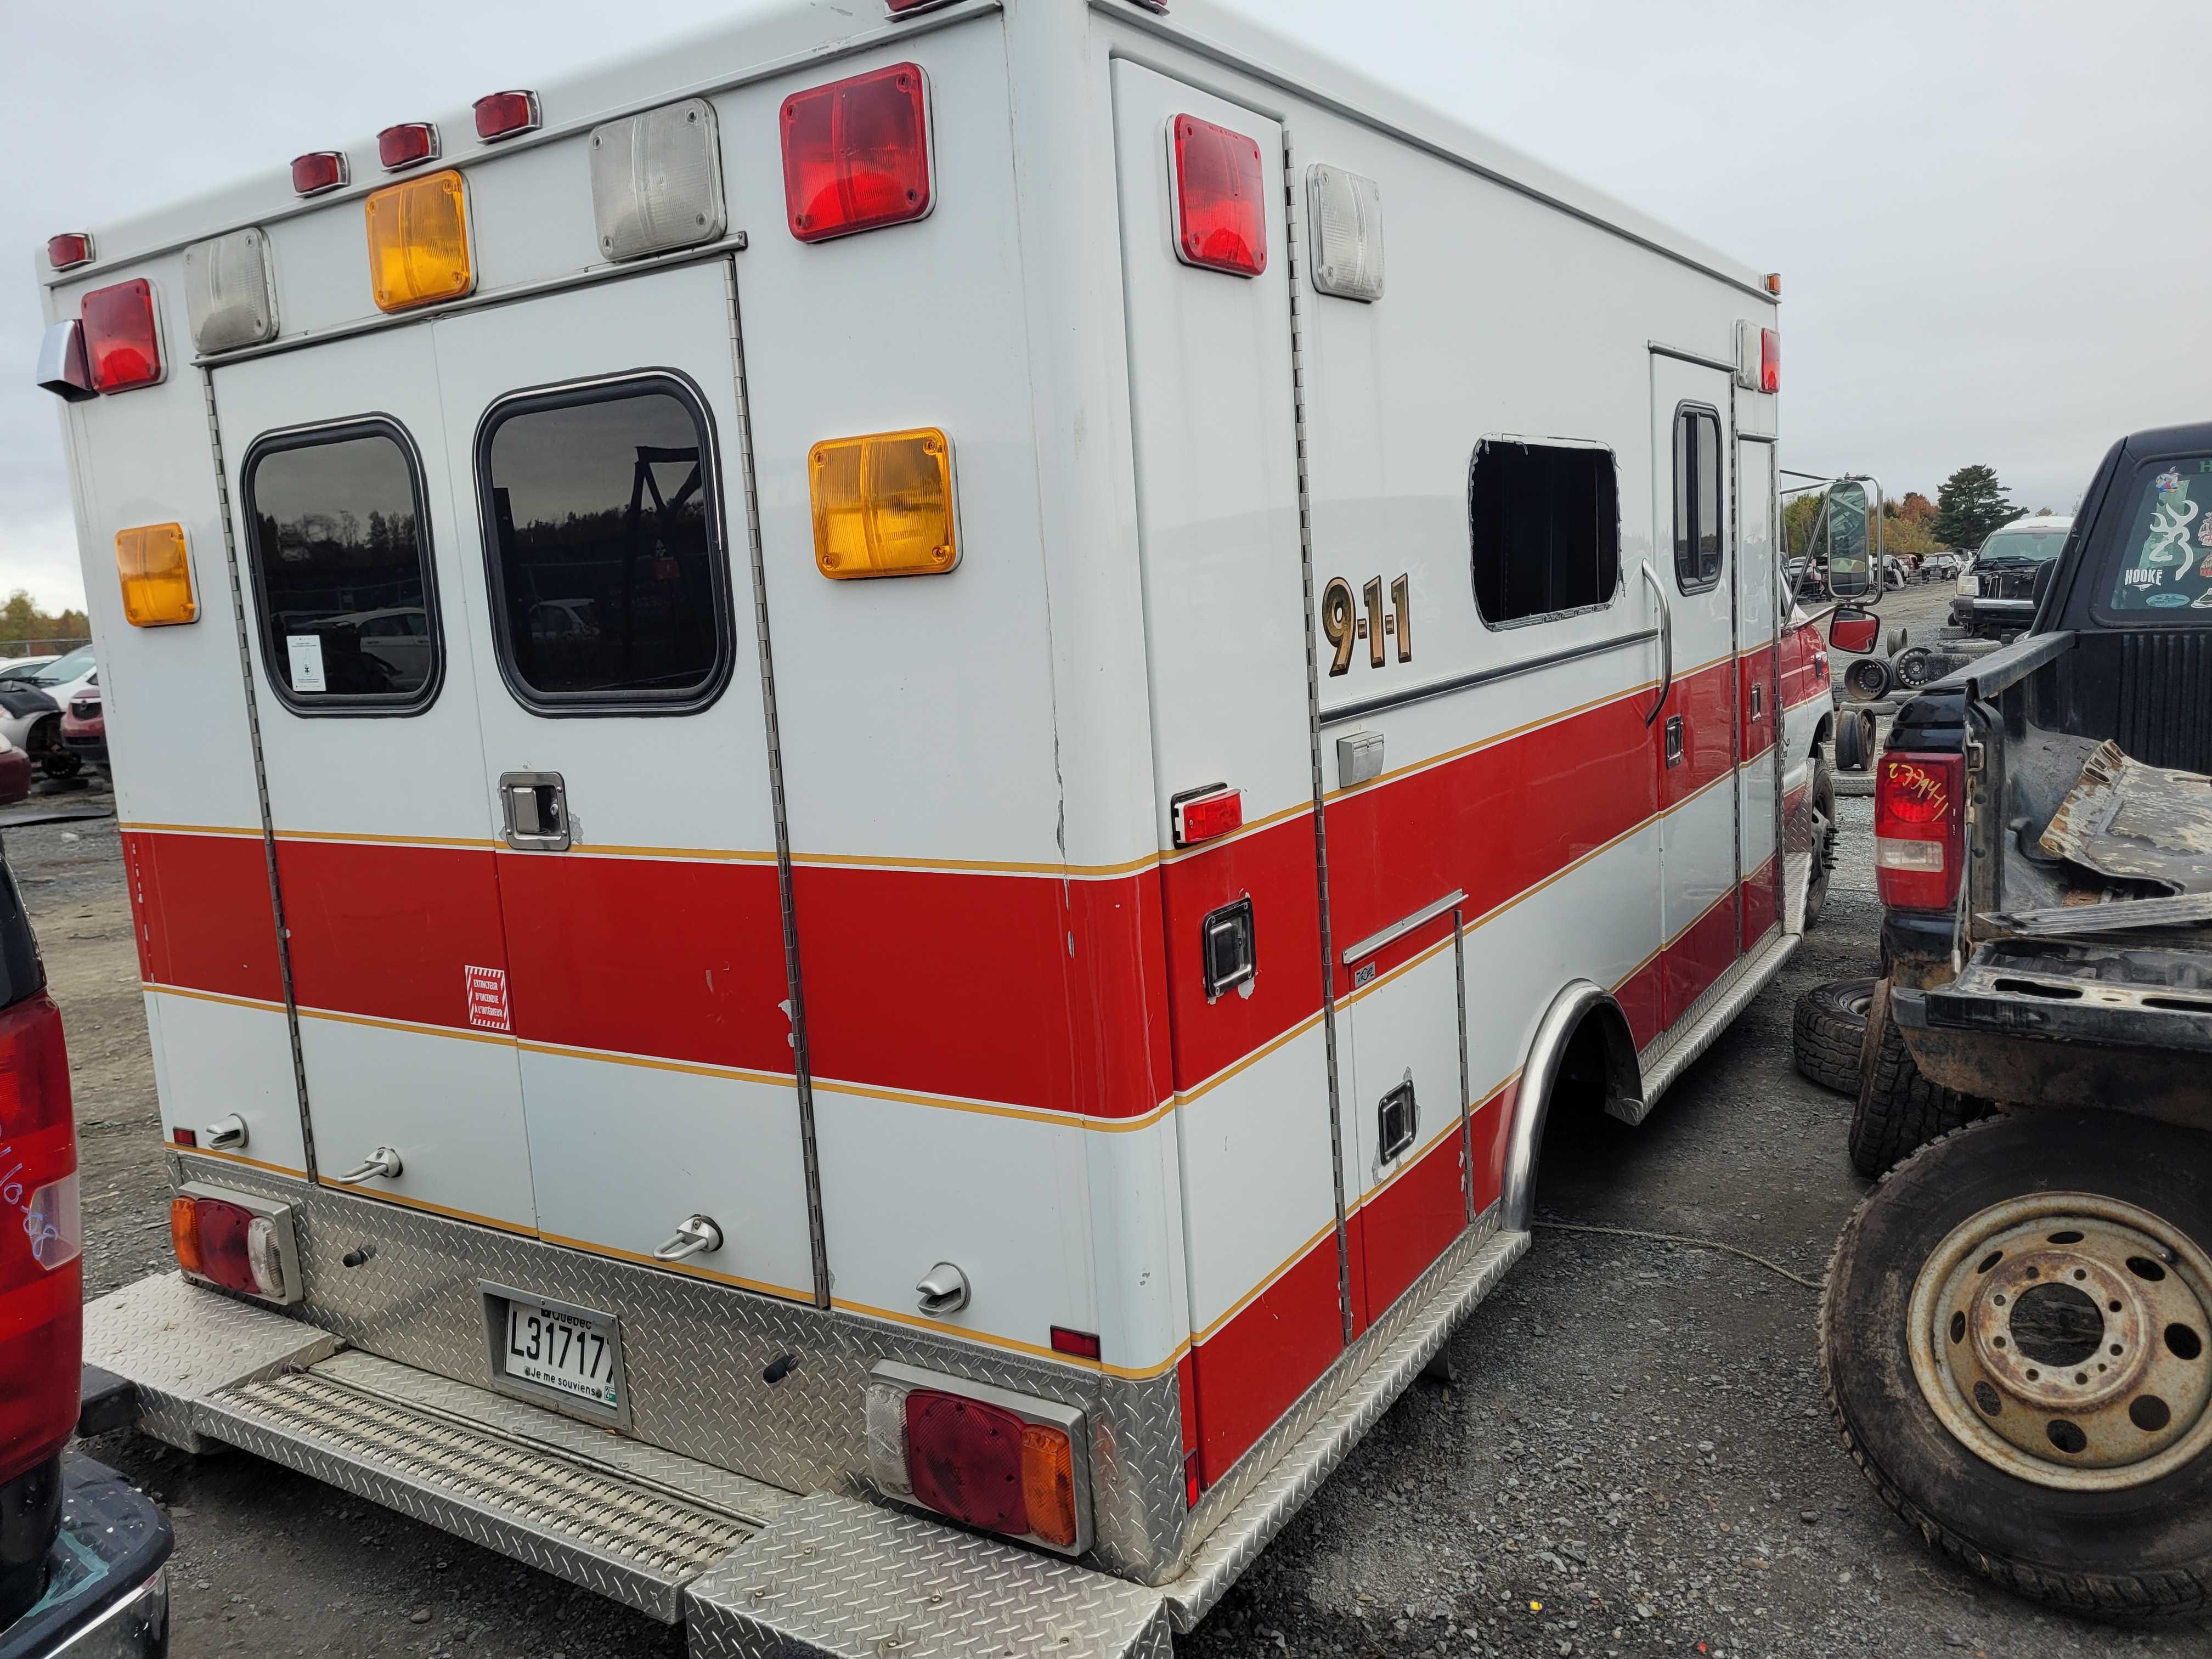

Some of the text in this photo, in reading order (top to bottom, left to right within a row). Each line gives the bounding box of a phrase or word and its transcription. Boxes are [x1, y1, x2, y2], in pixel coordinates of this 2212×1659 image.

[1322, 572, 1412, 678] 9-1-1
[473, 979, 498, 990] EXTINCTEUR
[531, 1367, 596, 1396] Je me souviens
